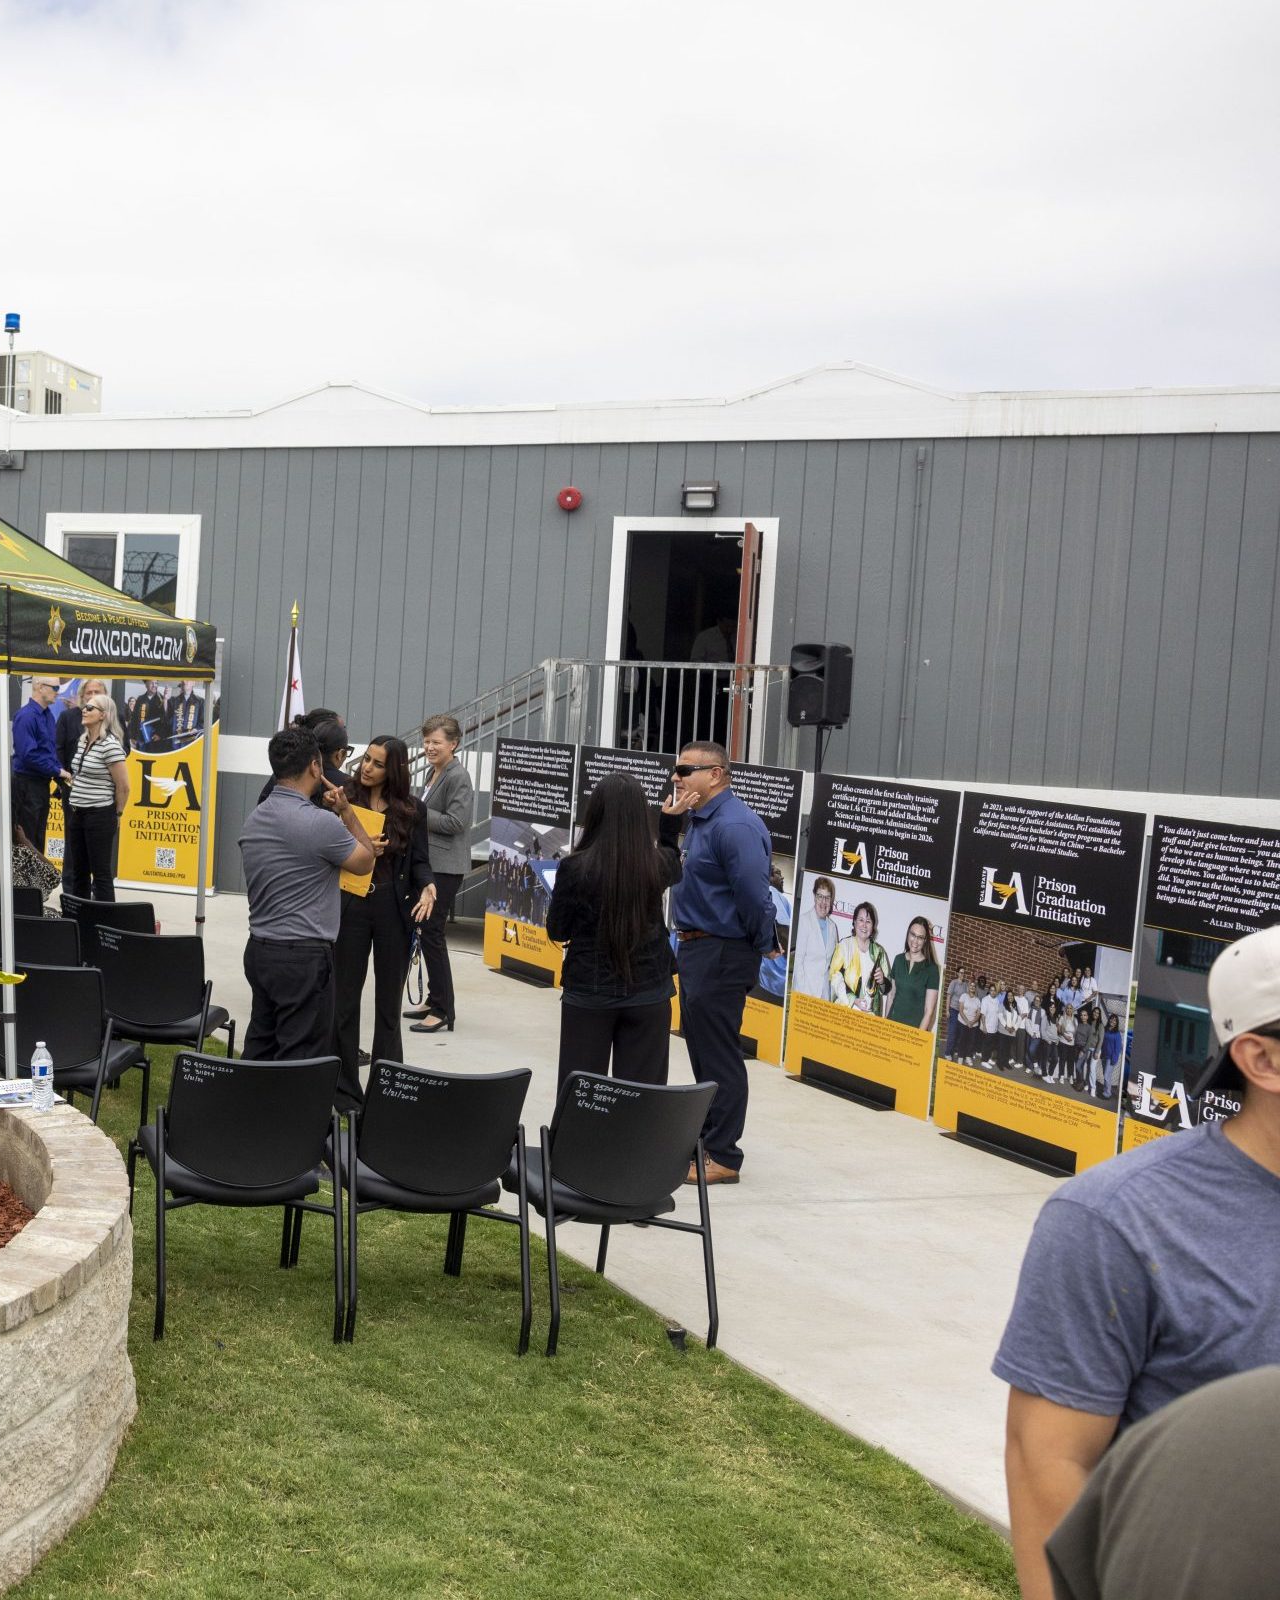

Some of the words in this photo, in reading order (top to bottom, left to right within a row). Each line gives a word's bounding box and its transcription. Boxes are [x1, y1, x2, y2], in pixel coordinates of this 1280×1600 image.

[70, 628, 183, 661] JOINCDCR.COM
[134, 759, 201, 811] LA
[832, 794, 857, 802] certificate
[858, 798, 881, 806] program
[888, 802, 921, 813] partnership
[923, 806, 935, 814] with
[896, 792, 914, 803] faculty
[916, 795, 938, 807] training
[147, 810, 188, 821] PRISON
[828, 800, 836, 808] Cal
[837, 802, 850, 810] State
[861, 806, 876, 814] CETL
[888, 810, 906, 818] added
[907, 812, 932, 823] Bachelor
[835, 811, 854, 820] Science
[861, 815, 884, 825] Business
[885, 819, 928, 832] Administration
[989, 803, 1003, 812] 2021,
[1065, 813, 1085, 822] Mellon
[1086, 816, 1120, 826] Foundation
[851, 822, 868, 832] degree
[895, 829, 910, 840] begin
[918, 834, 934, 842] 2026.
[987, 820, 998, 829] first
[998, 822, 1029, 832] face-to-face
[1058, 830, 1076, 839] degree
[1077, 835, 1102, 843] program
[1000, 813, 1019, 822] Bureau
[1026, 817, 1044, 825] Justice
[1046, 820, 1075, 830] Assistance,
[1089, 827, 1121, 836] established
[136, 831, 198, 844] INITIATIVE
[974, 827, 999, 836] California
[1000, 831, 1028, 841] Institution
[1039, 836, 1059, 846] Women
[1067, 841, 1084, 849] Chino
[1099, 846, 1126, 855] Bachelor
[1162, 836, 1178, 845] stuff
[1190, 840, 1204, 848] just
[1220, 844, 1246, 853] lectures
[1256, 849, 1270, 857] you
[1197, 831, 1210, 839] just
[1210, 833, 1228, 841] come
[1229, 834, 1244, 843] here
[832, 838, 871, 879] LA
[878, 845, 908, 860] Prison
[1036, 845, 1056, 854] Liberal
[1057, 848, 1079, 857] Studies.
[1215, 854, 1239, 862] human
[1240, 856, 1264, 867] beings.
[877, 858, 931, 878] Graduation
[1160, 855, 1185, 866] develop
[1186, 858, 1196, 866] the
[1197, 860, 1228, 872] language
[1229, 865, 1249, 874] where
[875, 871, 919, 888] Initiative
[1038, 876, 1077, 894] Prison
[1170, 868, 1201, 877] ourselves.
[1203, 870, 1215, 879] You
[1216, 875, 1244, 884] allowed
[979, 867, 1029, 915] LA
[1171, 886, 1186, 894] then
[1197, 891, 1219, 900] taught
[1234, 897, 1270, 910] something
[1223, 885, 1240, 894] tools,
[1036, 891, 1106, 915] Graduation
[1156, 893, 1177, 904] beings
[1178, 897, 1197, 906] inside
[1198, 900, 1215, 909] these
[1216, 904, 1238, 913] prison
[1035, 906, 1091, 927] Initiative
[381, 1068, 391, 1076] PO
[579, 1079, 590, 1088] PO
[1135, 1071, 1193, 1129] LA
[1205, 1090, 1241, 1112] Priso
